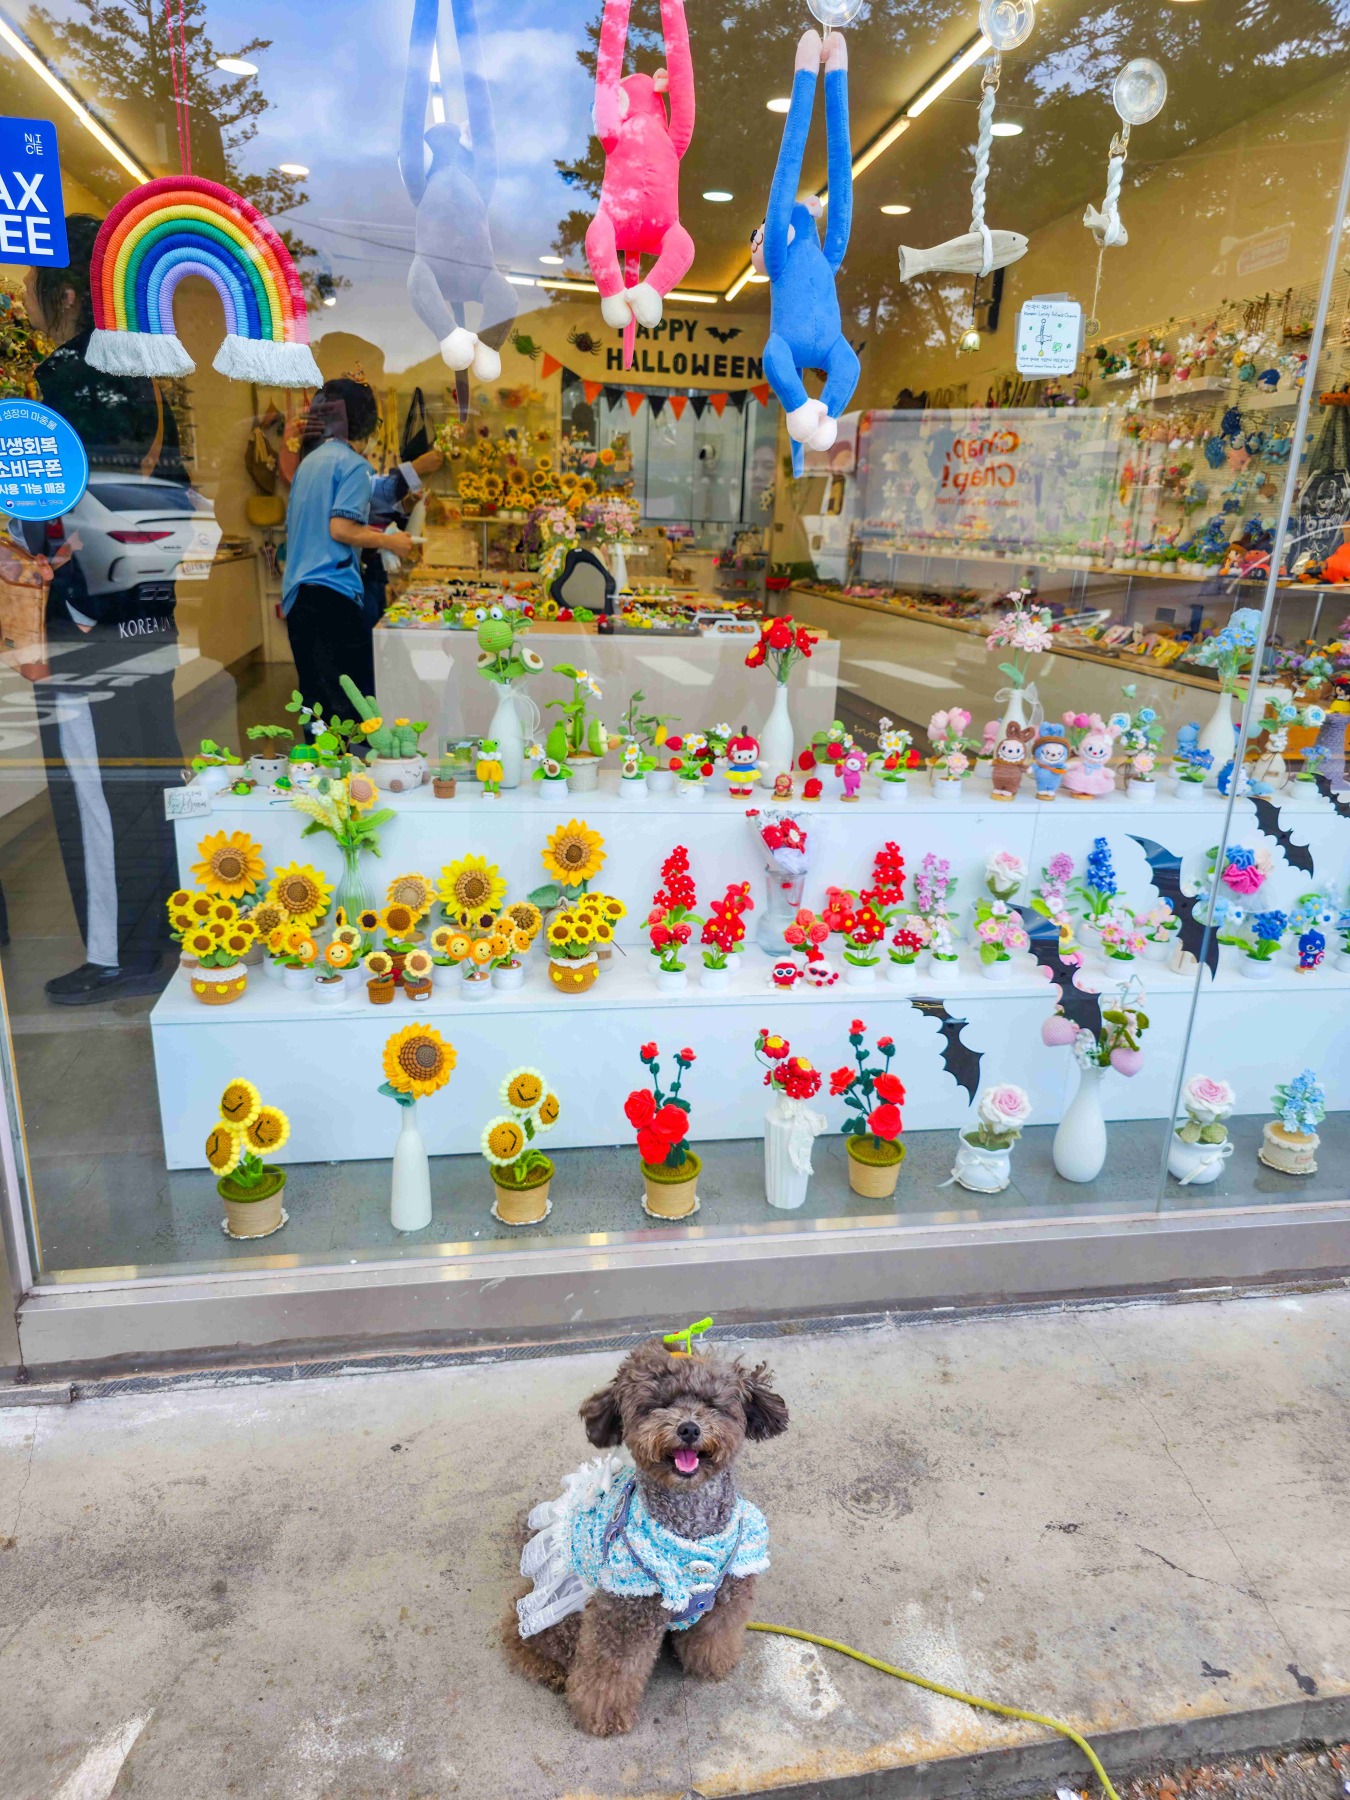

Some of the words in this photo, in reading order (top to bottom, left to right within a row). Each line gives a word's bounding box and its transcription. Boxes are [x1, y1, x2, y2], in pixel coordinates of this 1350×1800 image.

[618, 318, 698, 342] APPY
[3, 408, 29, 420] 성장의
[0, 459, 63, 478] 소비쿠폰
[0, 483, 19, 495] 사용
[20, 482, 43, 495] 가능
[44, 482, 66, 494] 매장
[118, 617, 160, 639] KOREA
